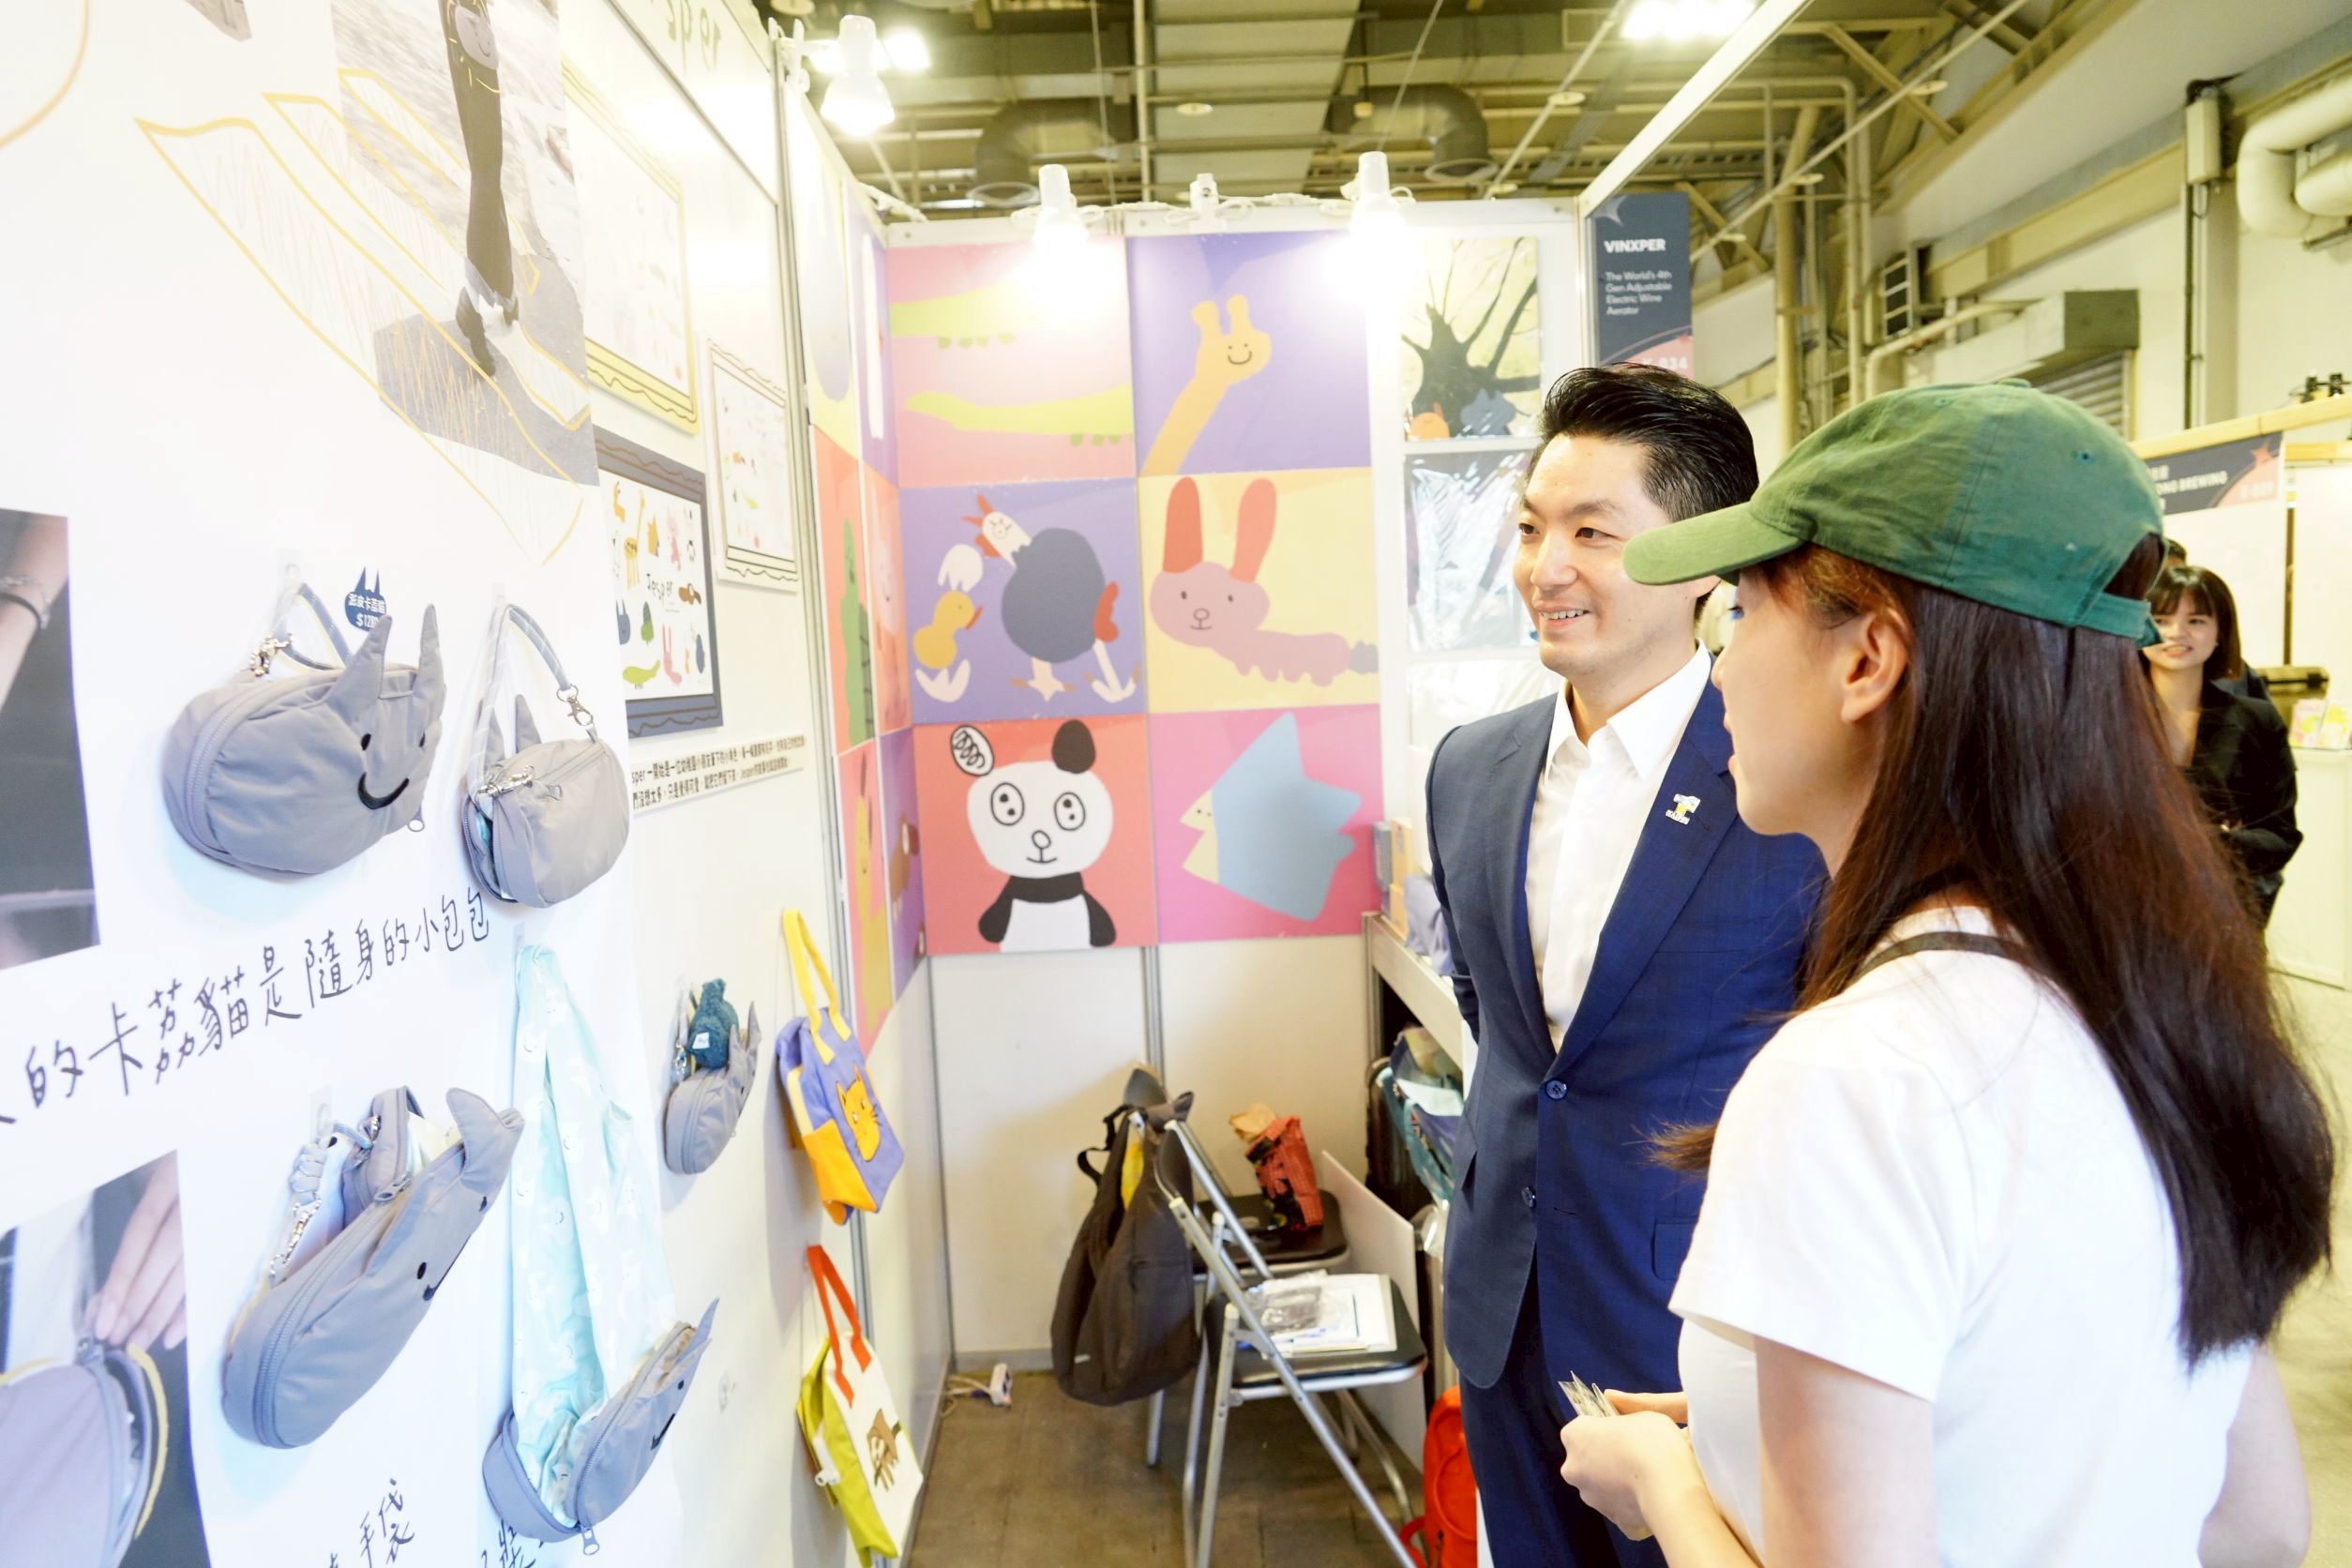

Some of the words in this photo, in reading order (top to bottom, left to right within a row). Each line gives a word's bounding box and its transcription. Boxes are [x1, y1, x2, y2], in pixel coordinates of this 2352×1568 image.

[1604, 238, 1666, 253] VINXPER
[1606, 271, 1622, 280] The
[1623, 270, 1655, 280] World's
[1657, 269, 1672, 279] 4th
[1606, 282, 1625, 293] Gen
[1626, 282, 1672, 293] Adjustable
[1606, 294, 1637, 304] Electric
[1638, 293, 1662, 303] Wine
[1606, 306, 1639, 316] Aerator
[2179, 470, 2228, 491] BREWING
[0, 886, 490, 1124] 的卡荔貓是隨身的小包包
